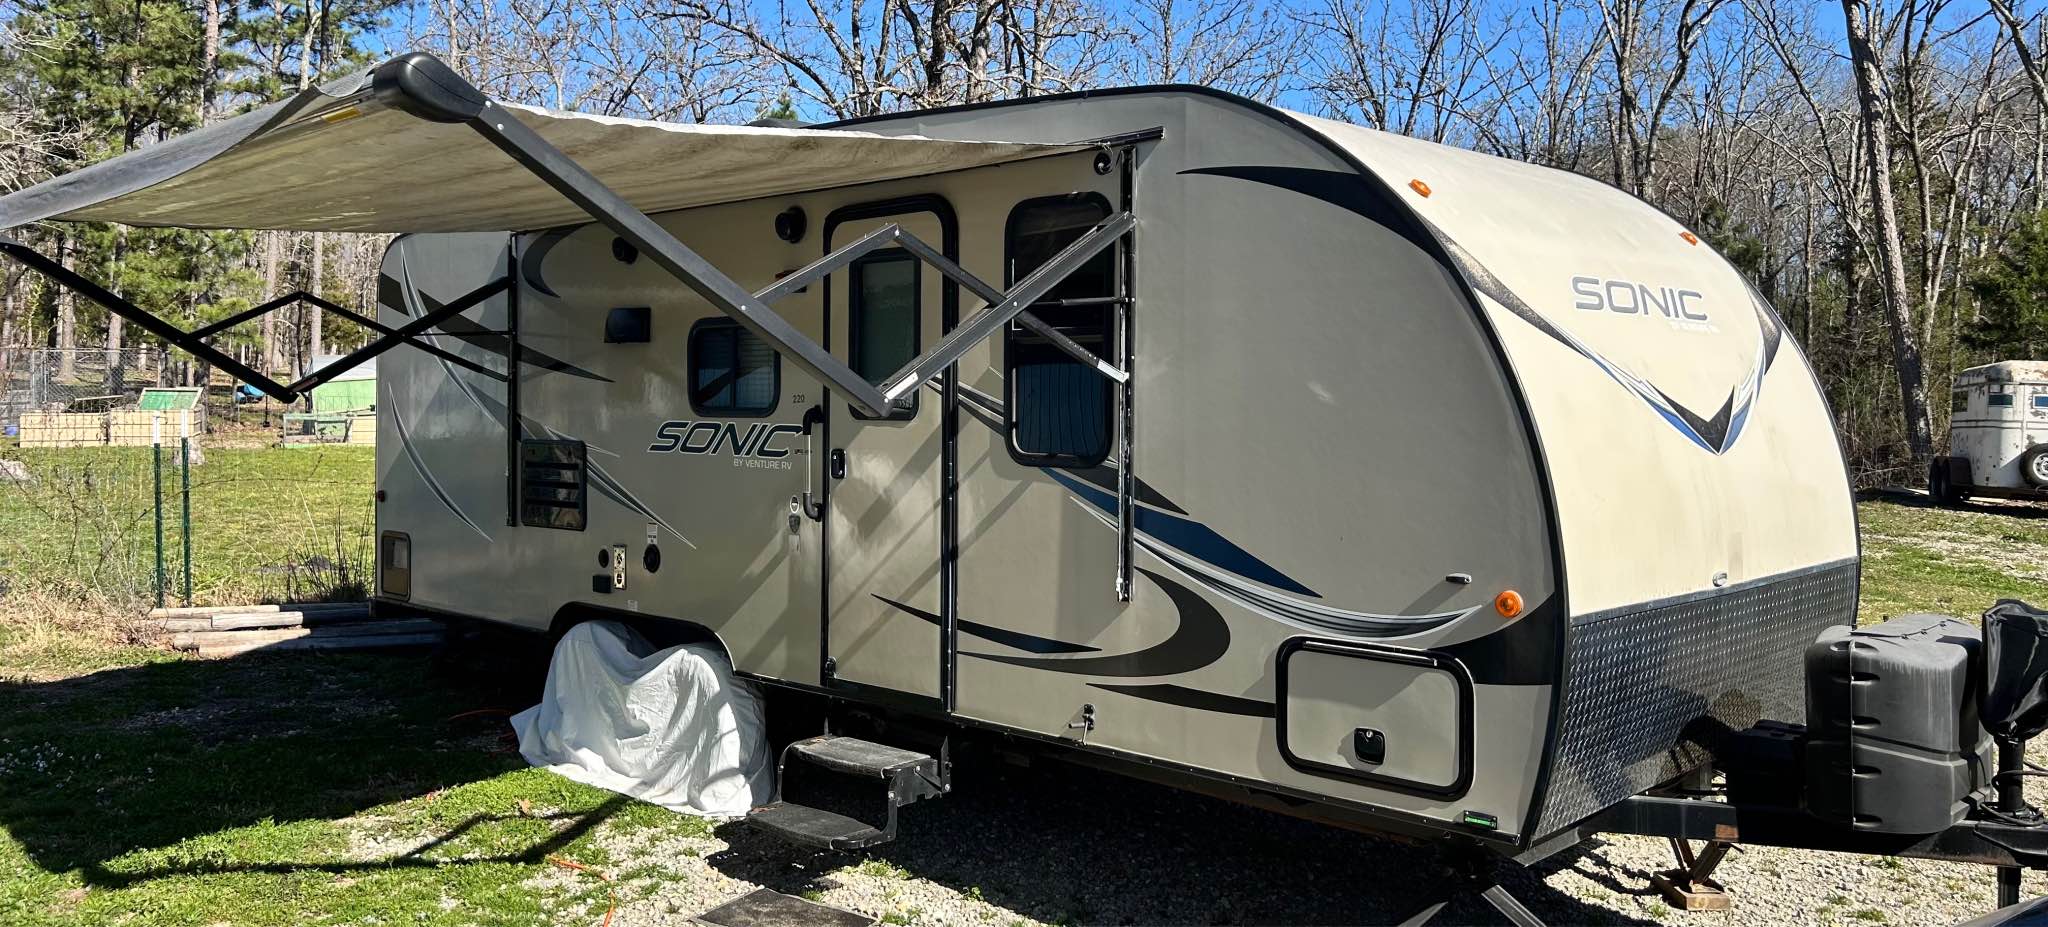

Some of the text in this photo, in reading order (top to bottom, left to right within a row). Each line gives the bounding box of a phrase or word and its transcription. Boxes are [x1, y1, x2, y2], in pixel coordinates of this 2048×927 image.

[1572, 275, 1708, 321] SONIC
[793, 394, 805, 404] 220
[648, 420, 803, 459] SONIC
[733, 458, 793, 470] BY VENTURE RV
